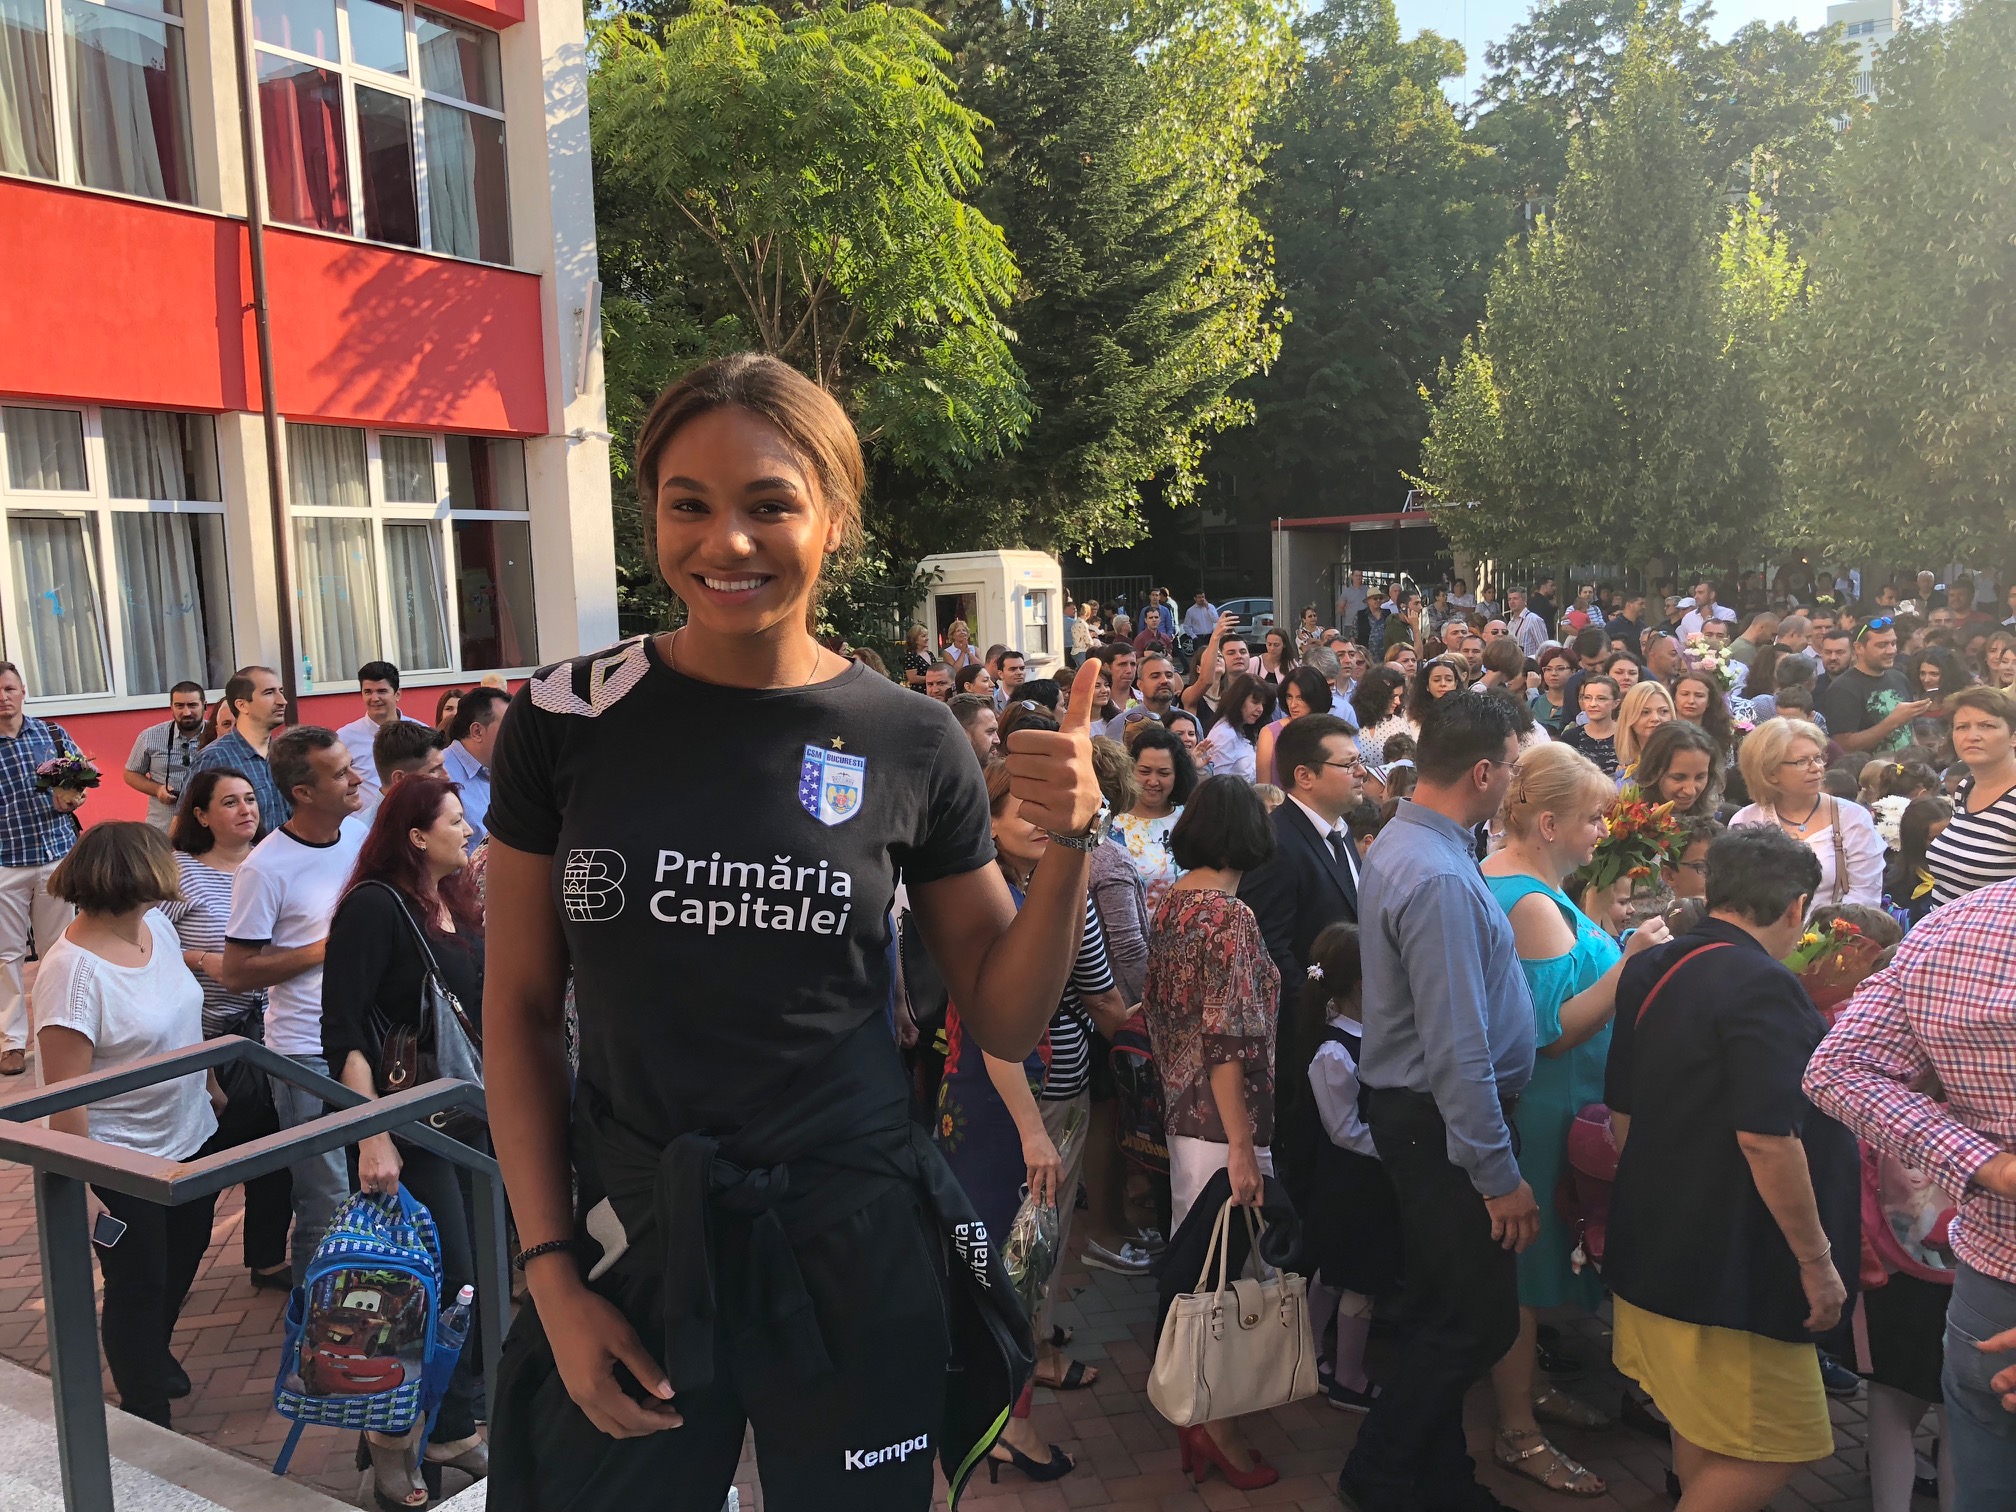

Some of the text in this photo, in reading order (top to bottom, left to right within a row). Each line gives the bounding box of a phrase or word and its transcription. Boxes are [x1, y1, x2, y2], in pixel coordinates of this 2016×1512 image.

[806, 748, 864, 768] CSM BUCURESTI
[655, 849, 852, 897] Primăria
[650, 890, 852, 935] Capitalei
[969, 1221, 992, 1291] pitalei
[845, 1433, 928, 1471] Kempa
